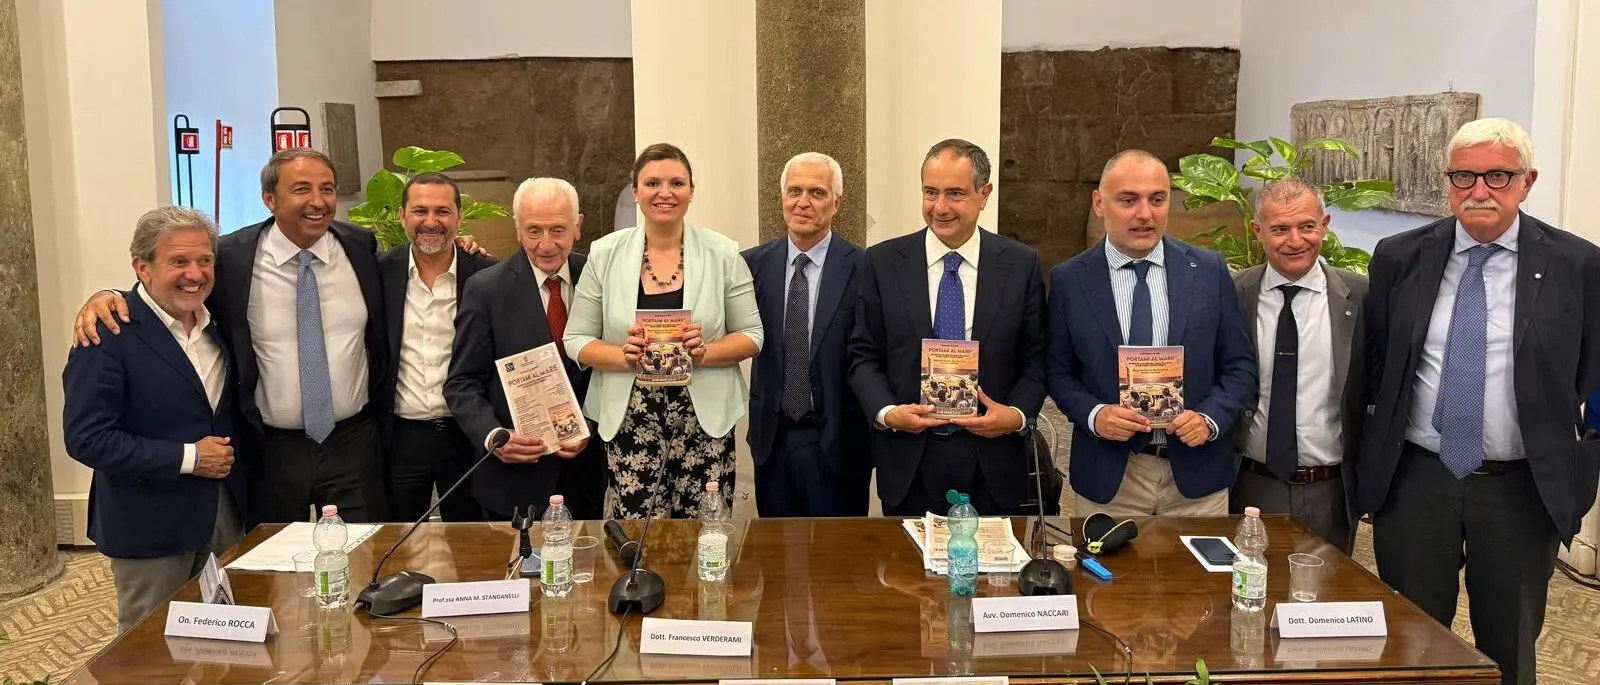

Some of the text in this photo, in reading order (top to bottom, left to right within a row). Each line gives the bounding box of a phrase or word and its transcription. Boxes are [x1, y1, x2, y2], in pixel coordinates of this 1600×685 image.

[482, 592, 520, 600] STANGANELLI
[1000, 610, 1036, 618] Domenico
[178, 616, 255, 629] On. Federico ROCCA
[668, 634, 700, 642] Francesco
[702, 635, 742, 643] VERDERAMI
